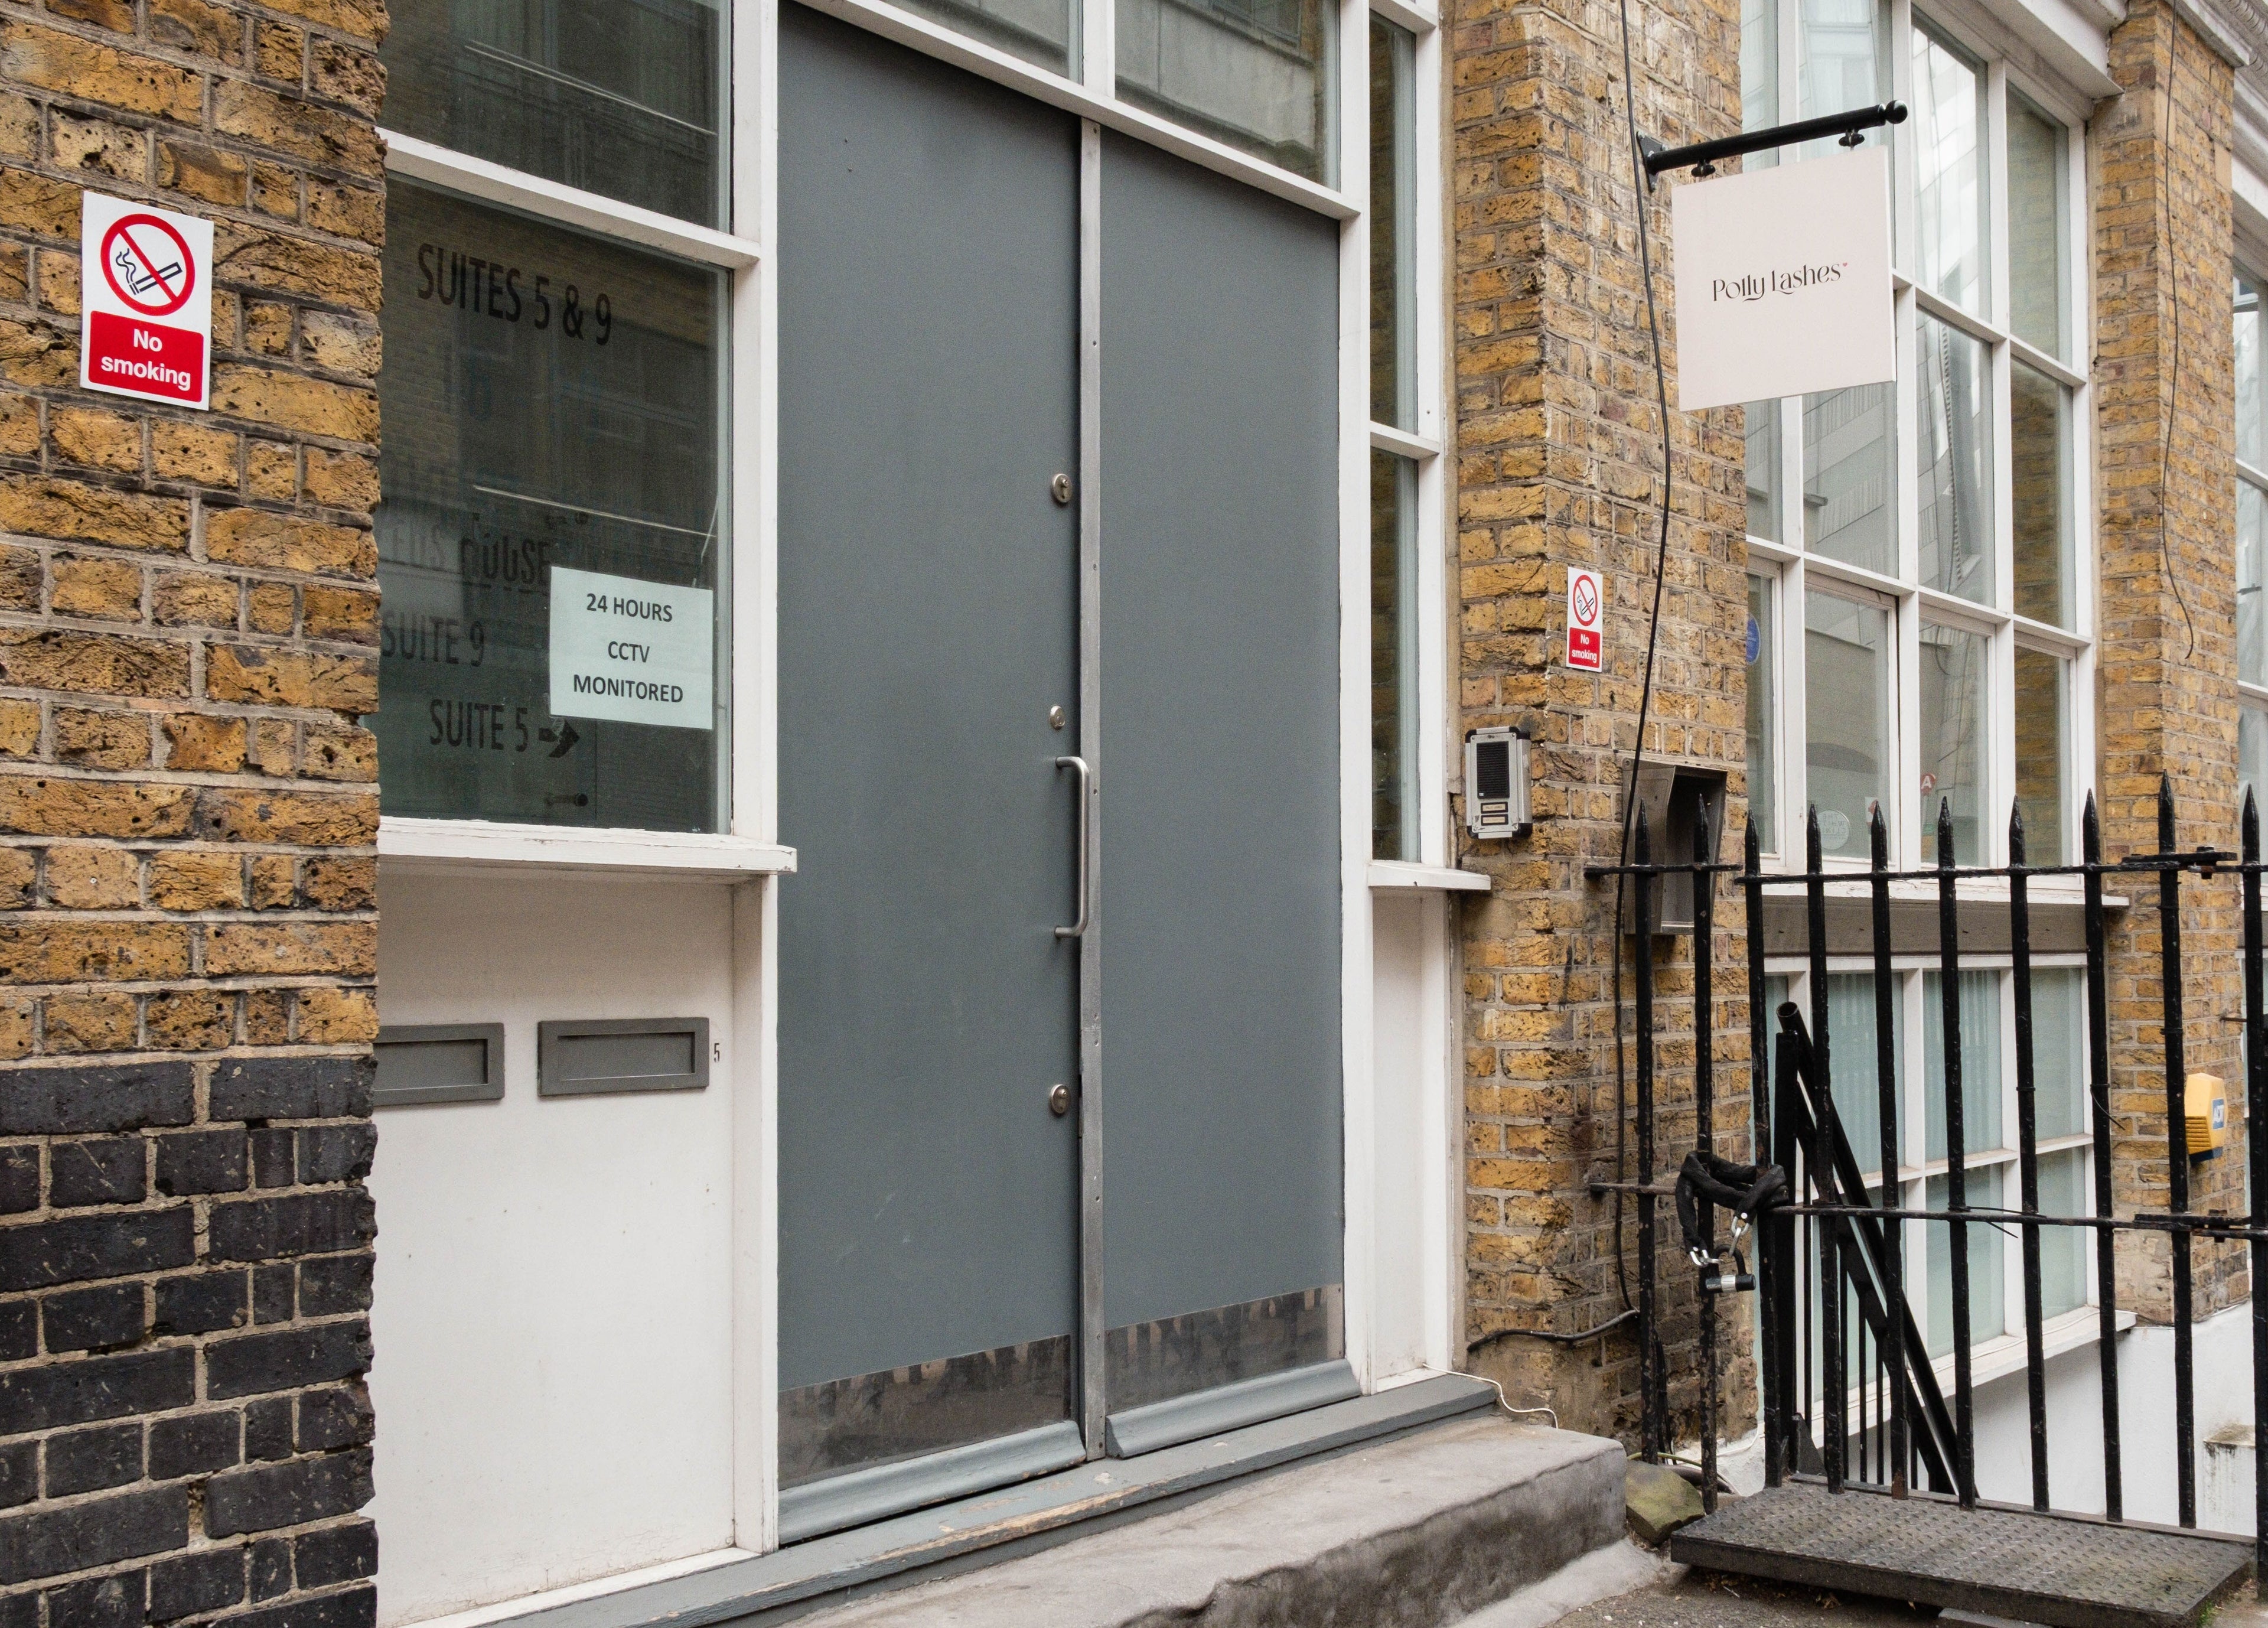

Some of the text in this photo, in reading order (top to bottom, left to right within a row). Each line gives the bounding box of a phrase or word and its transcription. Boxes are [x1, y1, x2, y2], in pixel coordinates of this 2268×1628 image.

[418, 243, 612, 345] SUITES 5 & 9
[1712, 263, 1842, 302] Polly Lashes
[133, 328, 162, 352] No
[100, 356, 191, 392] smoking
[586, 592, 673, 623] 24 HOURS
[381, 609, 485, 668] SUITE 9
[608, 640, 650, 663] CCTV
[1581, 634, 1589, 644] No
[1572, 649, 1597, 663] smoking
[573, 674, 684, 703] MONITORED
[429, 698, 529, 753] SUITE 5
[1921, 775, 1932, 789] A
[713, 1042, 720, 1063] 5
